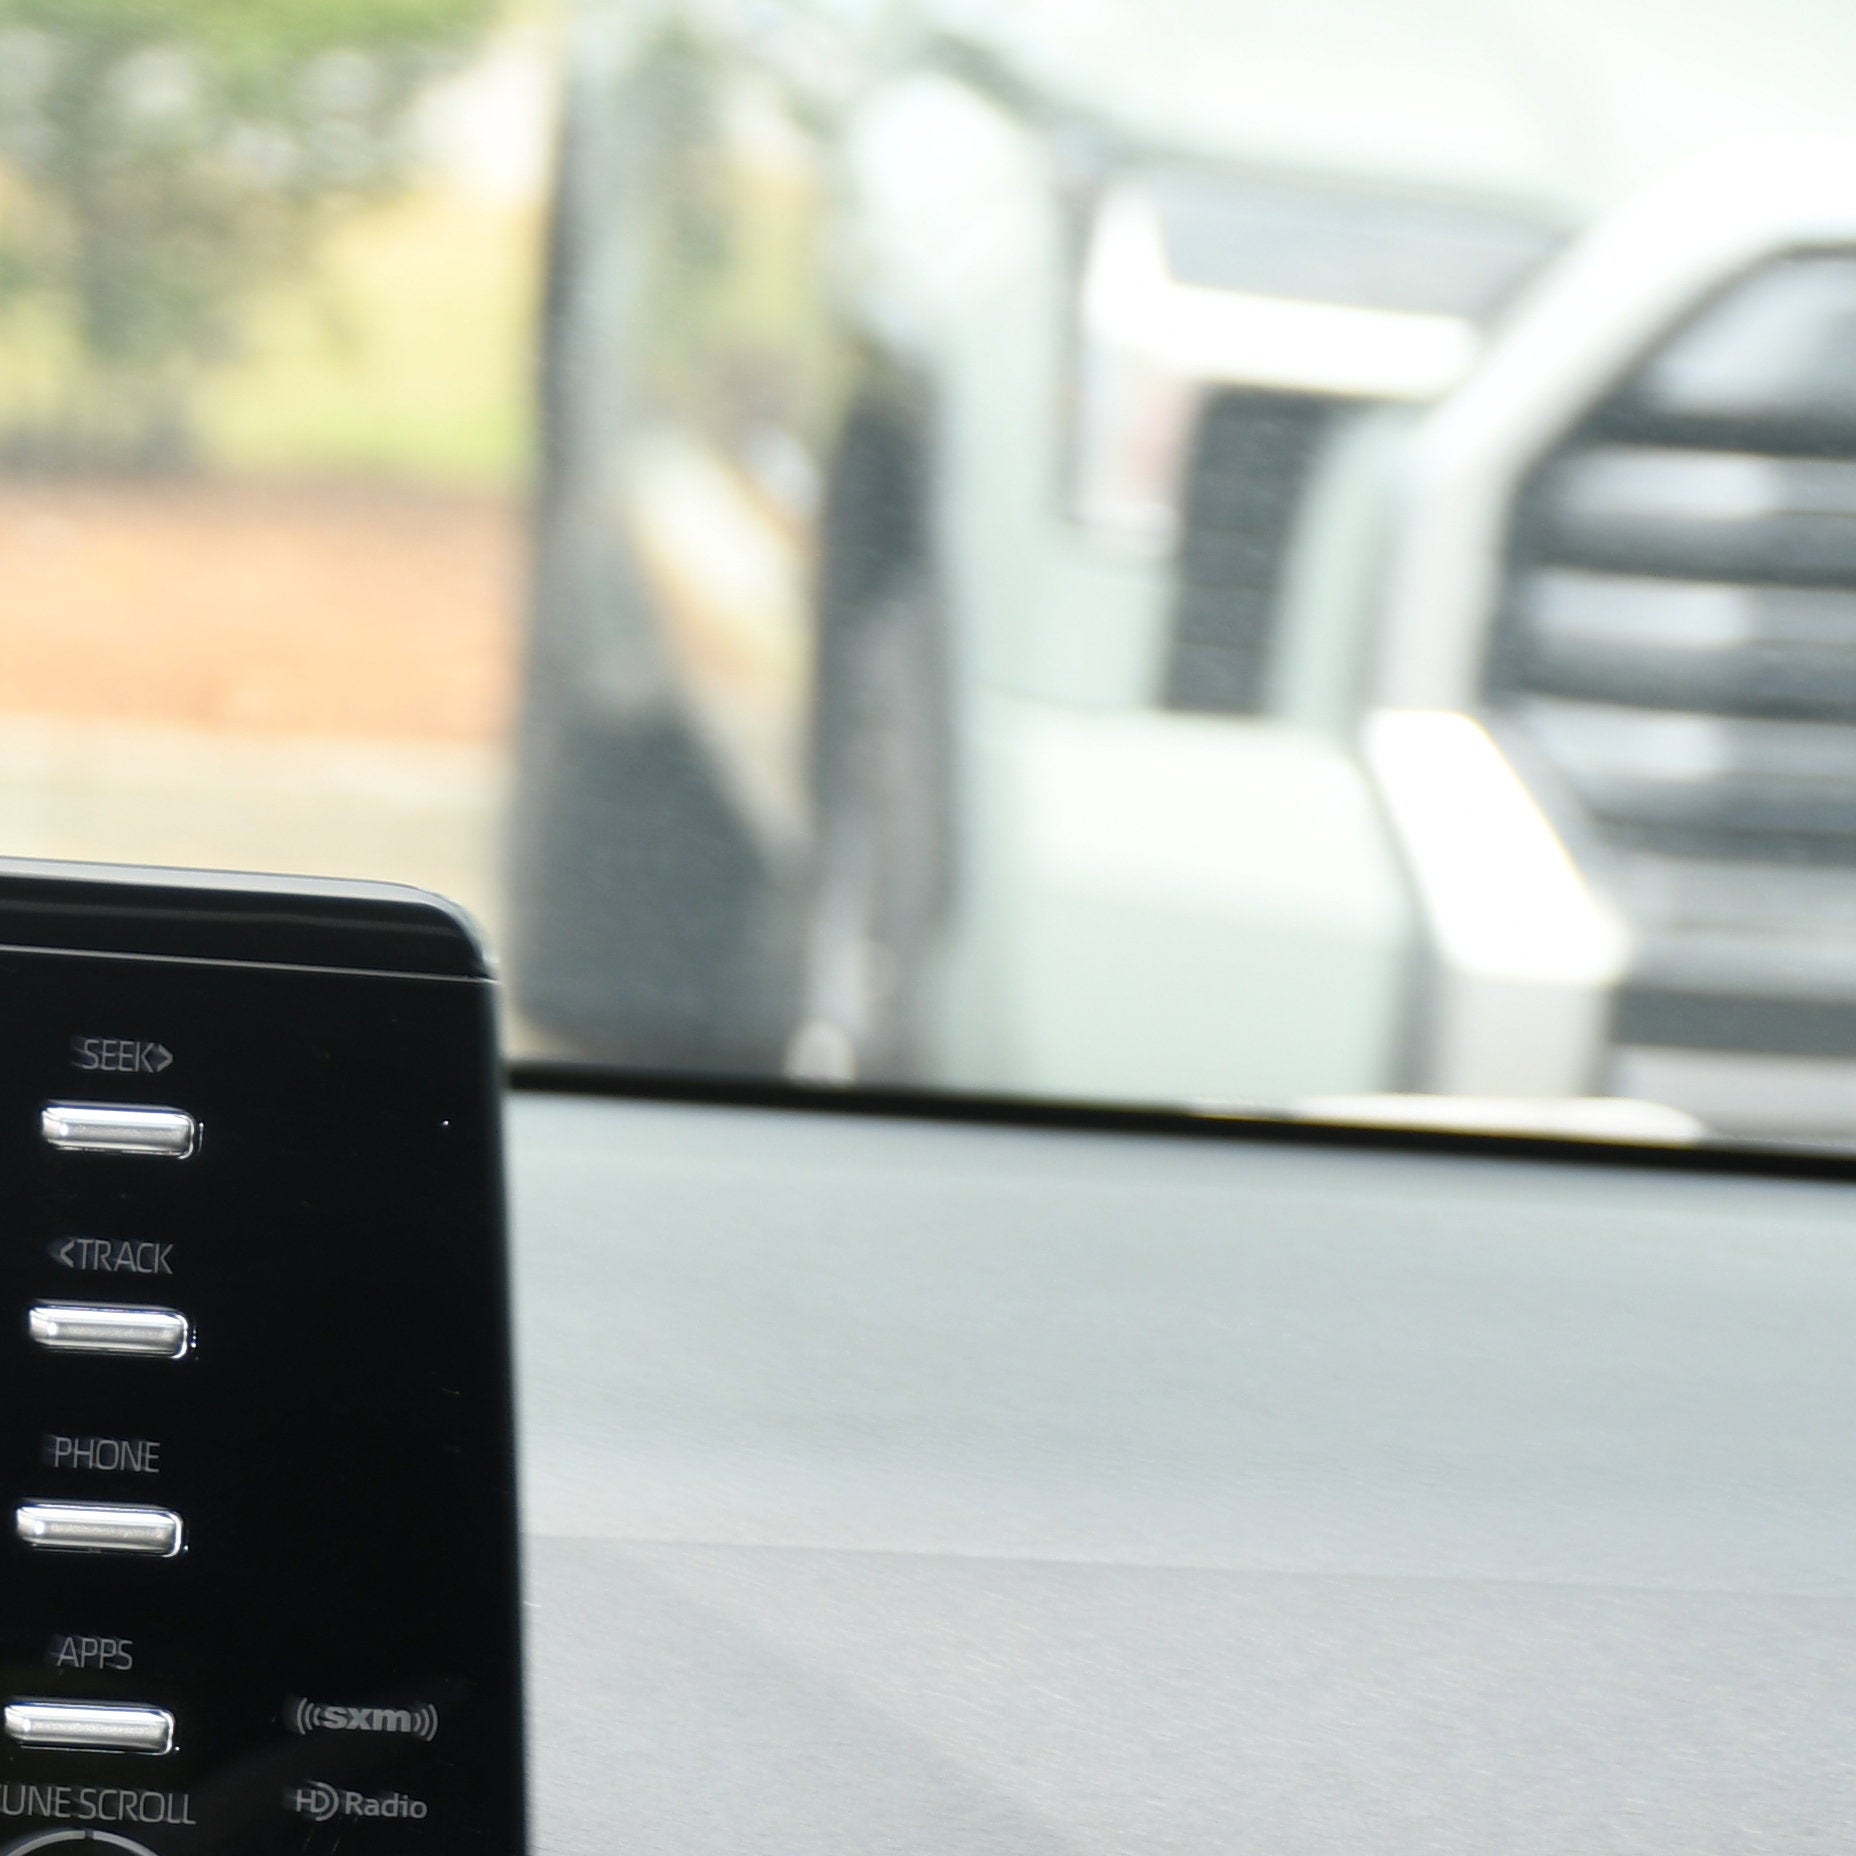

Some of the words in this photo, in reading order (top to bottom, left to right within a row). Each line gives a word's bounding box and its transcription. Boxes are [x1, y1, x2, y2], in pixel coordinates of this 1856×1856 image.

[54, 1436, 162, 1473] PHONE
[55, 1635, 134, 1671] APPS
[77, 1788, 197, 1826] SCROLL
[345, 1789, 428, 1820] Radio
